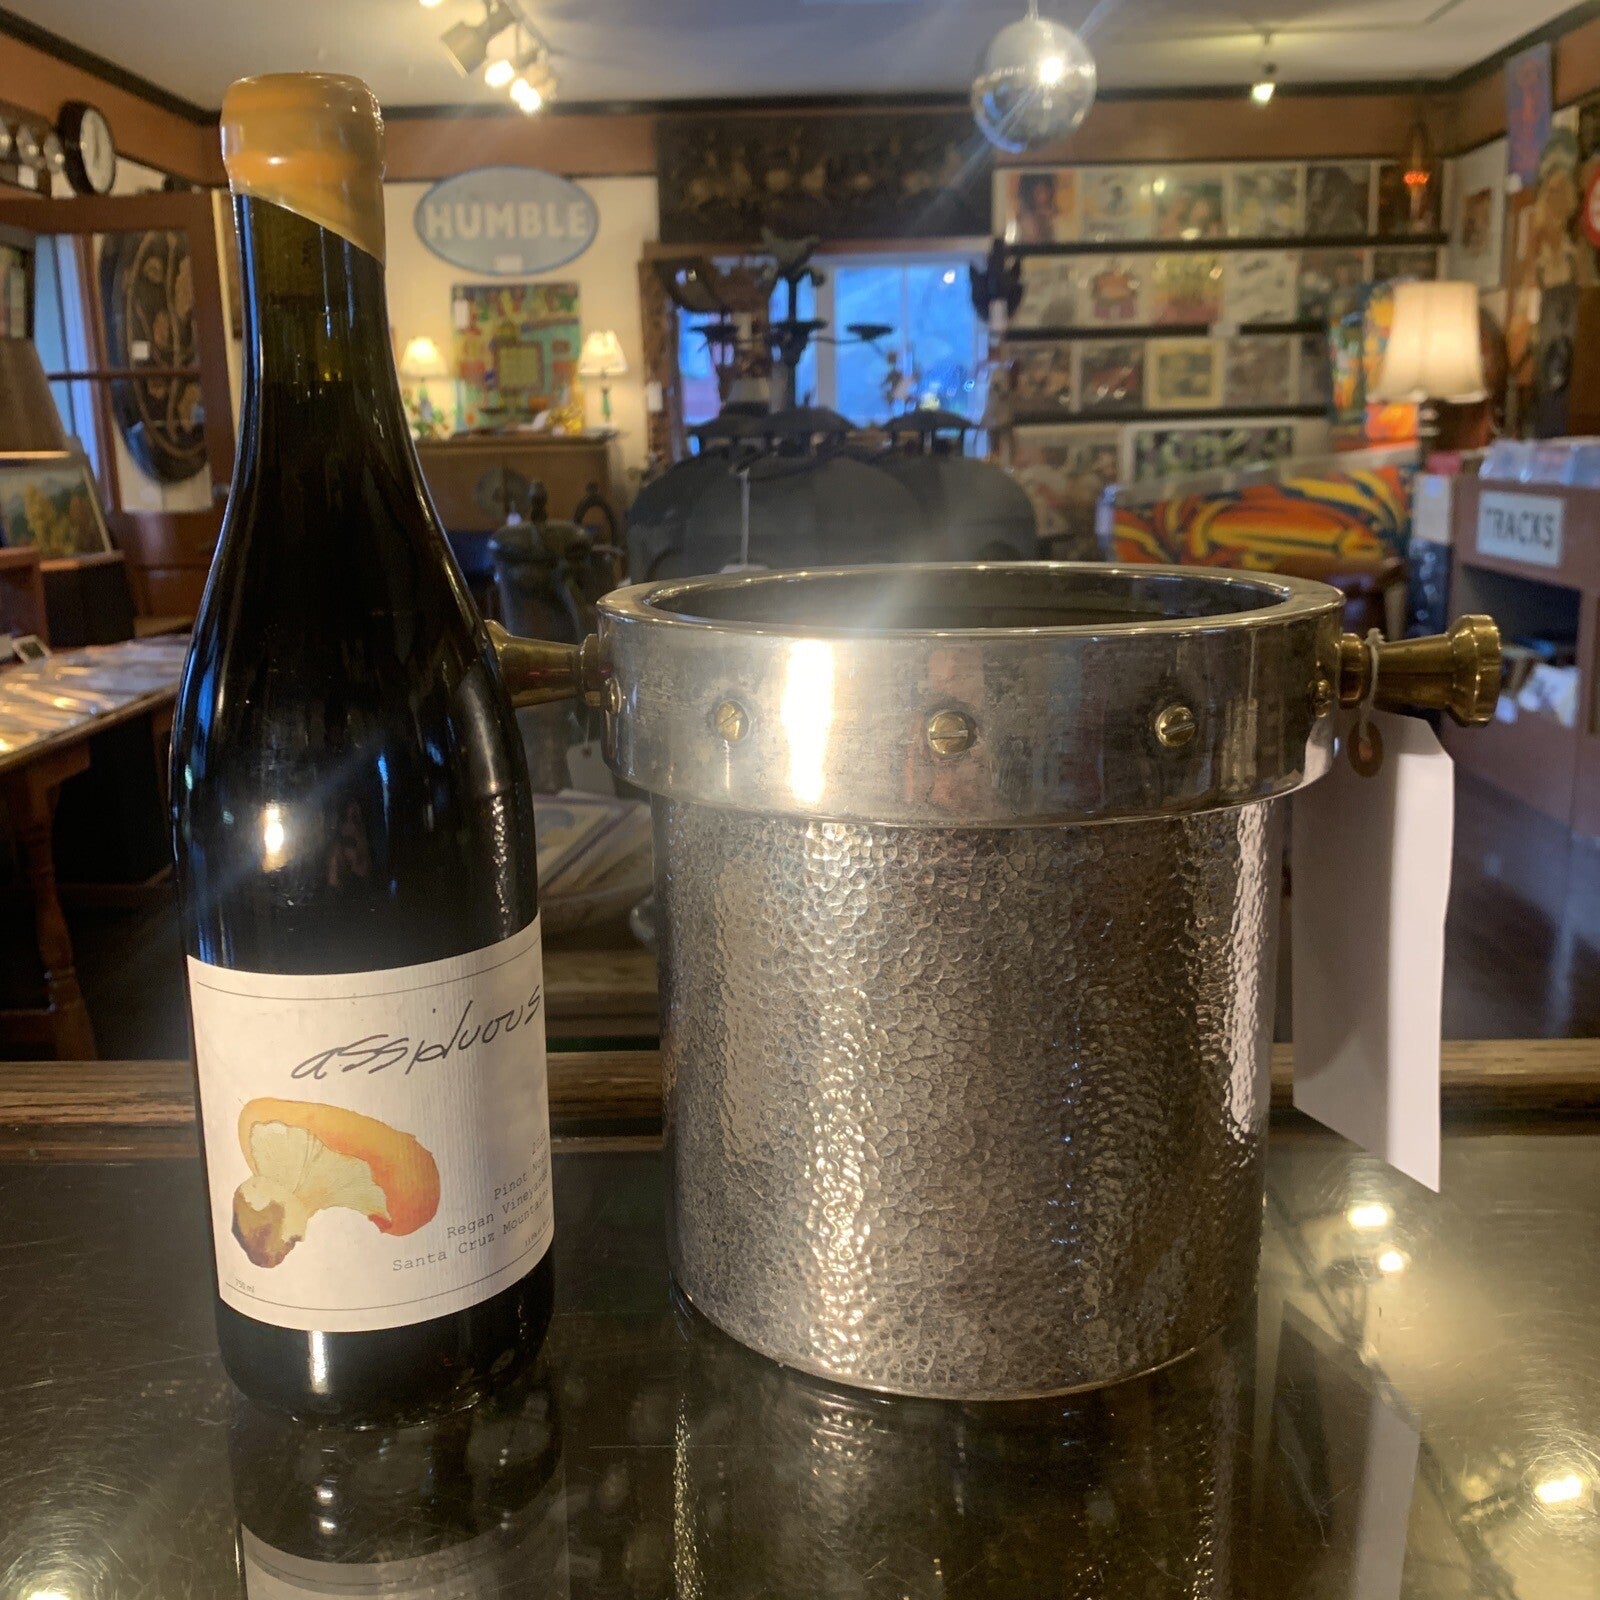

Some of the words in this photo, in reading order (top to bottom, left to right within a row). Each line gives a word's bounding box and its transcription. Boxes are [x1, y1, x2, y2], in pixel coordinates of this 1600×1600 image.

[424, 202, 587, 240] HUMBLE
[1485, 507, 1556, 549] TRACKS
[494, 1172, 528, 1200] Pinot
[447, 1212, 494, 1239] Regan
[393, 1251, 447, 1271] Santa
[458, 1232, 495, 1254] Cruz
